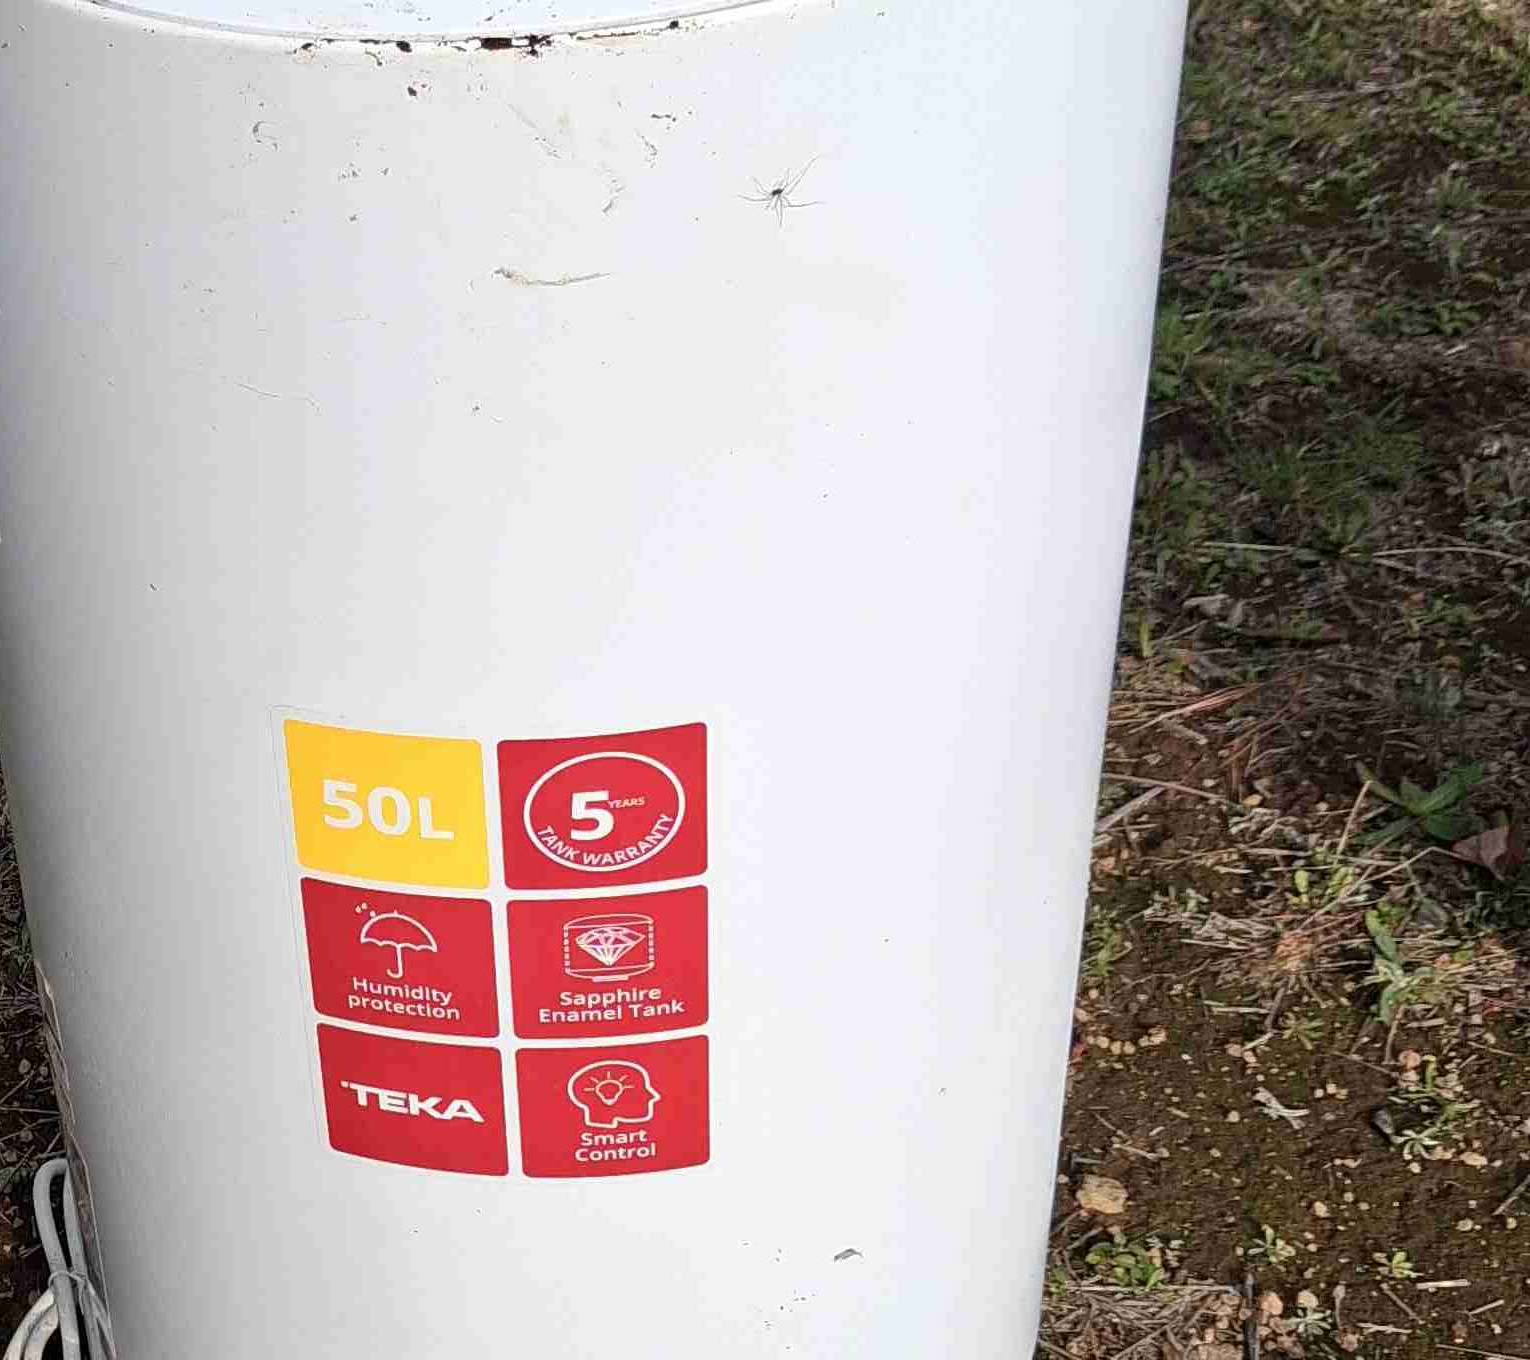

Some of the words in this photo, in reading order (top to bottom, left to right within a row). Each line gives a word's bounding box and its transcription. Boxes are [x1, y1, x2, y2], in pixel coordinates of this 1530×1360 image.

[322, 779, 454, 841] 50L
[570, 791, 615, 841] 5
[607, 796, 646, 810] YEARS
[536, 824, 581, 862] TANK
[582, 812, 674, 867] WARRANTY
[352, 976, 454, 1005] Humidity
[559, 986, 662, 1014] Sapphire
[347, 993, 461, 1022] protection
[539, 1005, 624, 1024] Enamel
[628, 998, 686, 1020] Tank
[340, 1079, 485, 1124] TEKA
[575, 1143, 657, 1163] Control
[580, 1129, 648, 1148] Smart
